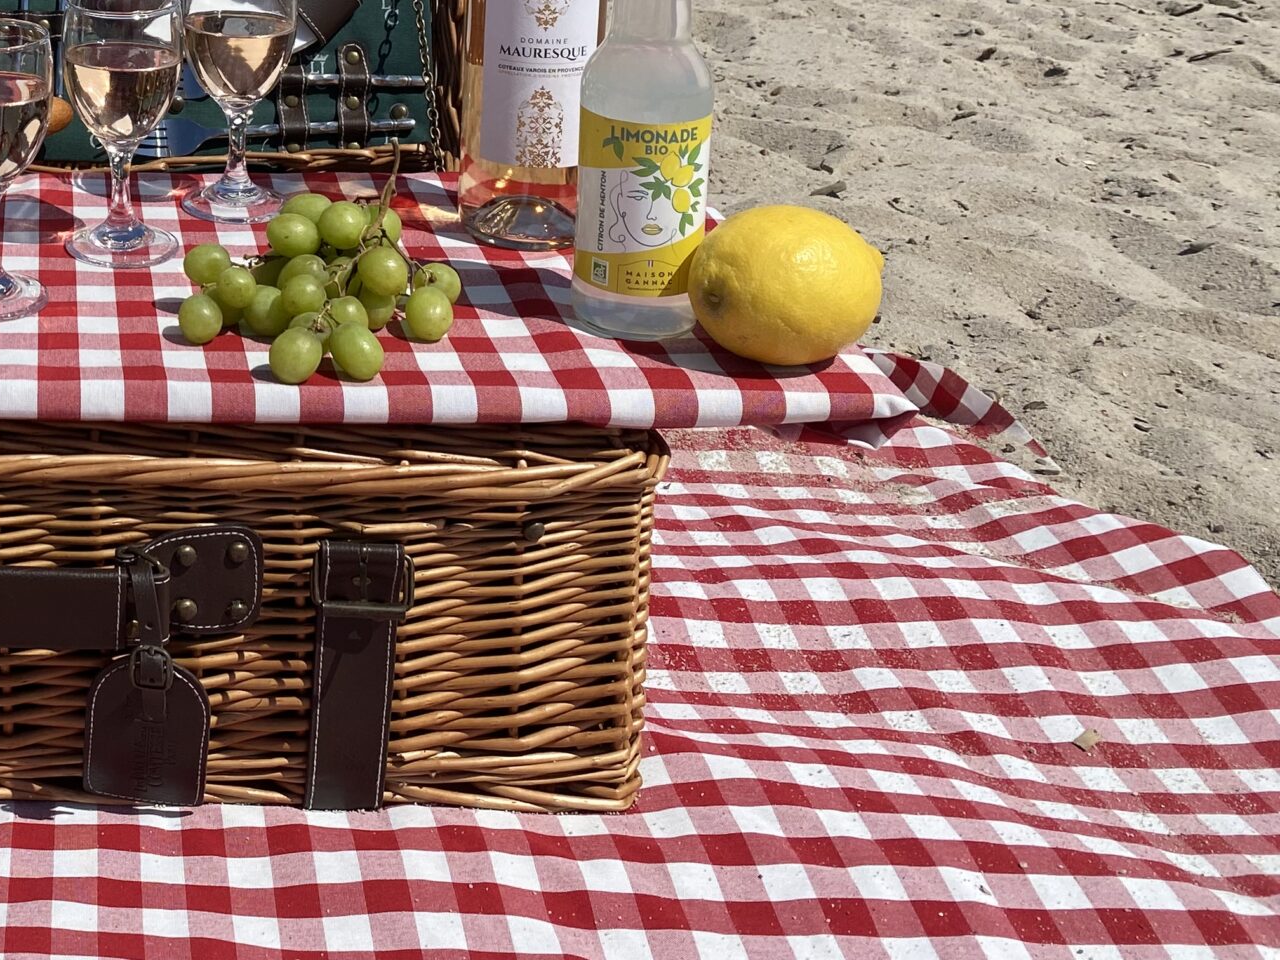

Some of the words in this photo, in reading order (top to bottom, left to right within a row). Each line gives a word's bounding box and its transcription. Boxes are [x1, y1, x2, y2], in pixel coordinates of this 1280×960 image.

[520, 37, 568, 45] DOMAINE
[499, 44, 587, 61] MAURESQUE
[498, 64, 524, 72] COTEAUX
[557, 66, 585, 74] PROVENCE
[610, 125, 698, 145] LIMONADE
[645, 145, 668, 155] BIO
[599, 170, 607, 207] MENTON
[599, 208, 606, 219] DE
[597, 220, 606, 251] CITRON
[625, 278, 673, 286] GANNAC
